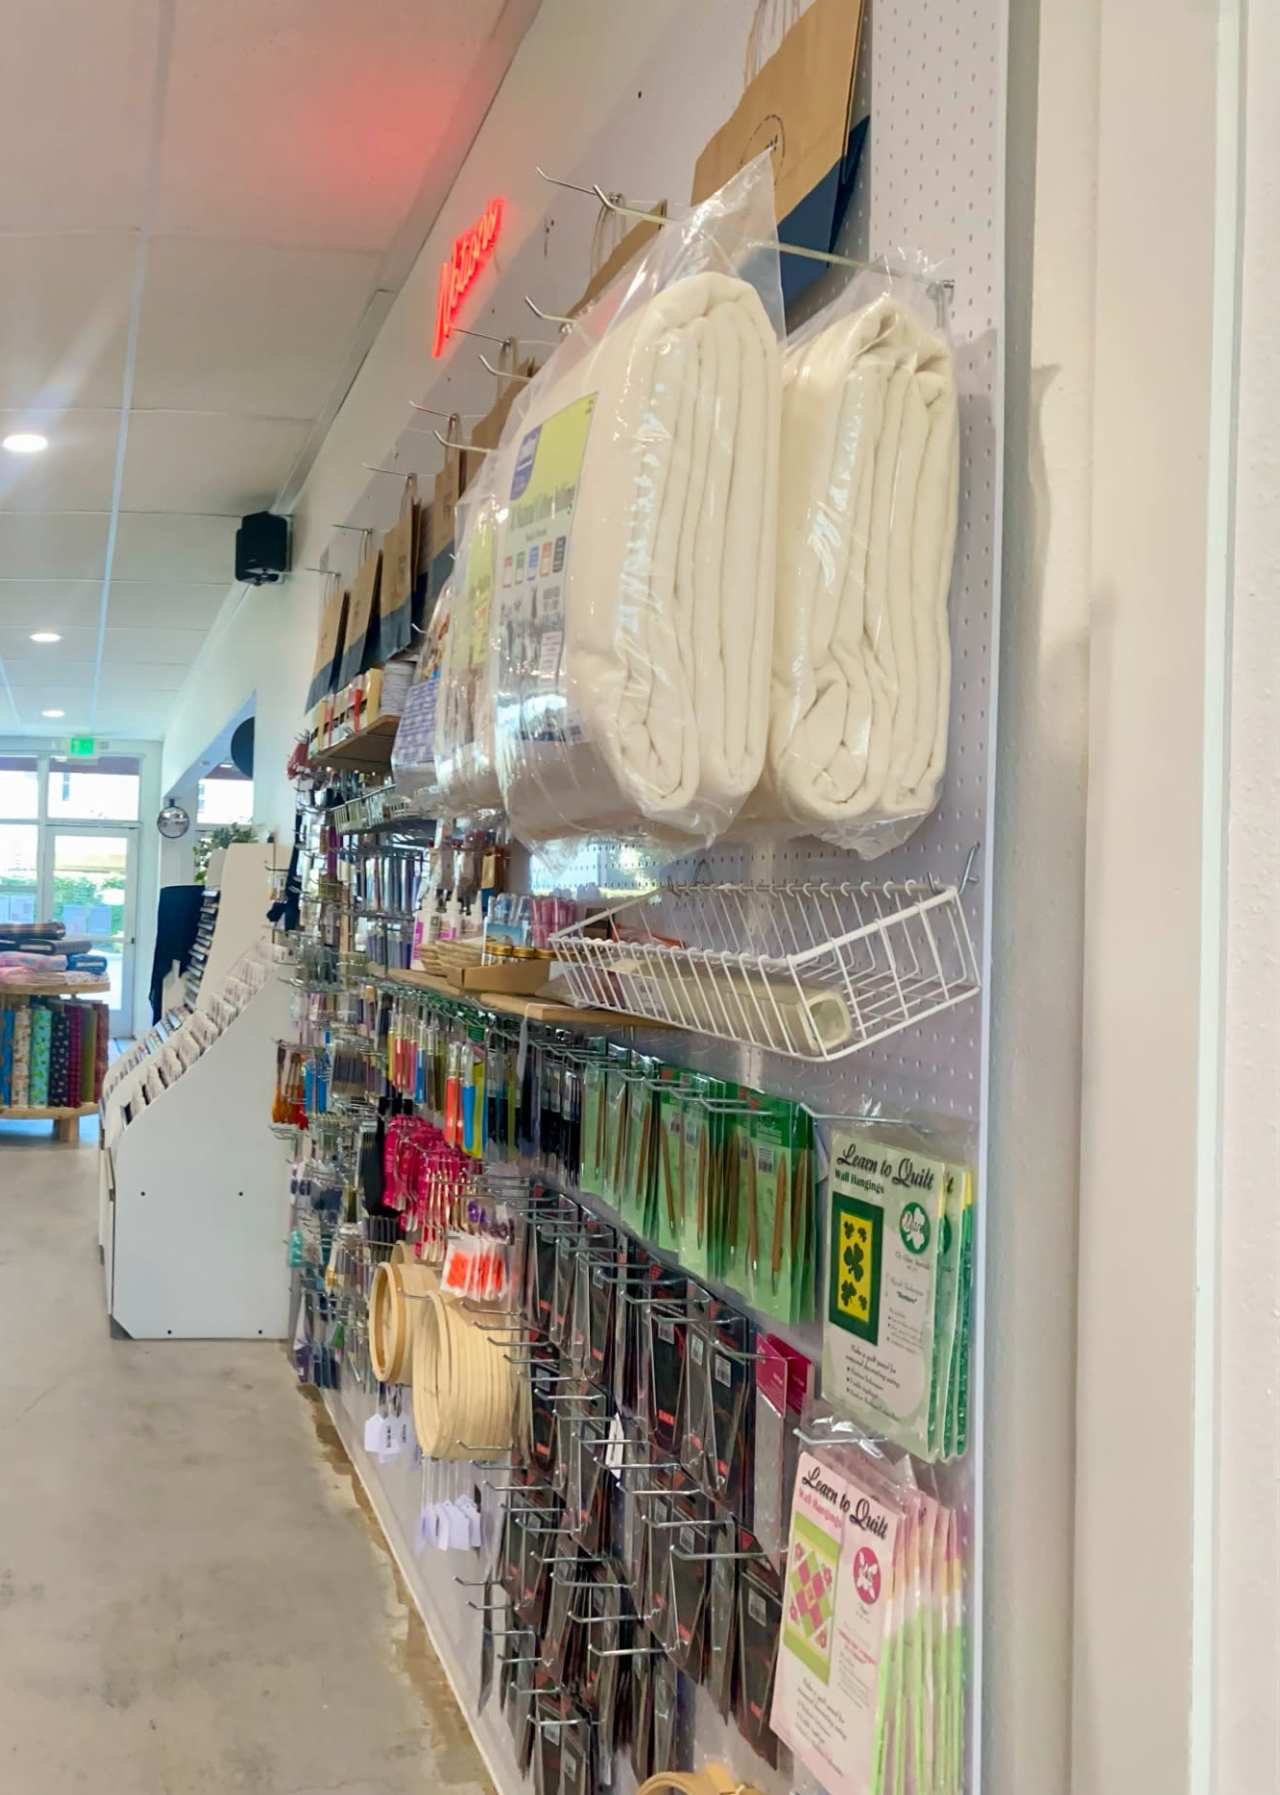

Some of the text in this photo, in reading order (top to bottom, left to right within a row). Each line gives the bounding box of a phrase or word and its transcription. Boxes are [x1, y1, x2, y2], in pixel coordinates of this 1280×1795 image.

[835, 1168, 850, 1182] Wall
[836, 1143, 878, 1172] Learn
[879, 1160, 893, 1178] to
[892, 1157, 935, 1191] Quilt
[801, 1466, 890, 1541] Learn to Quilt
